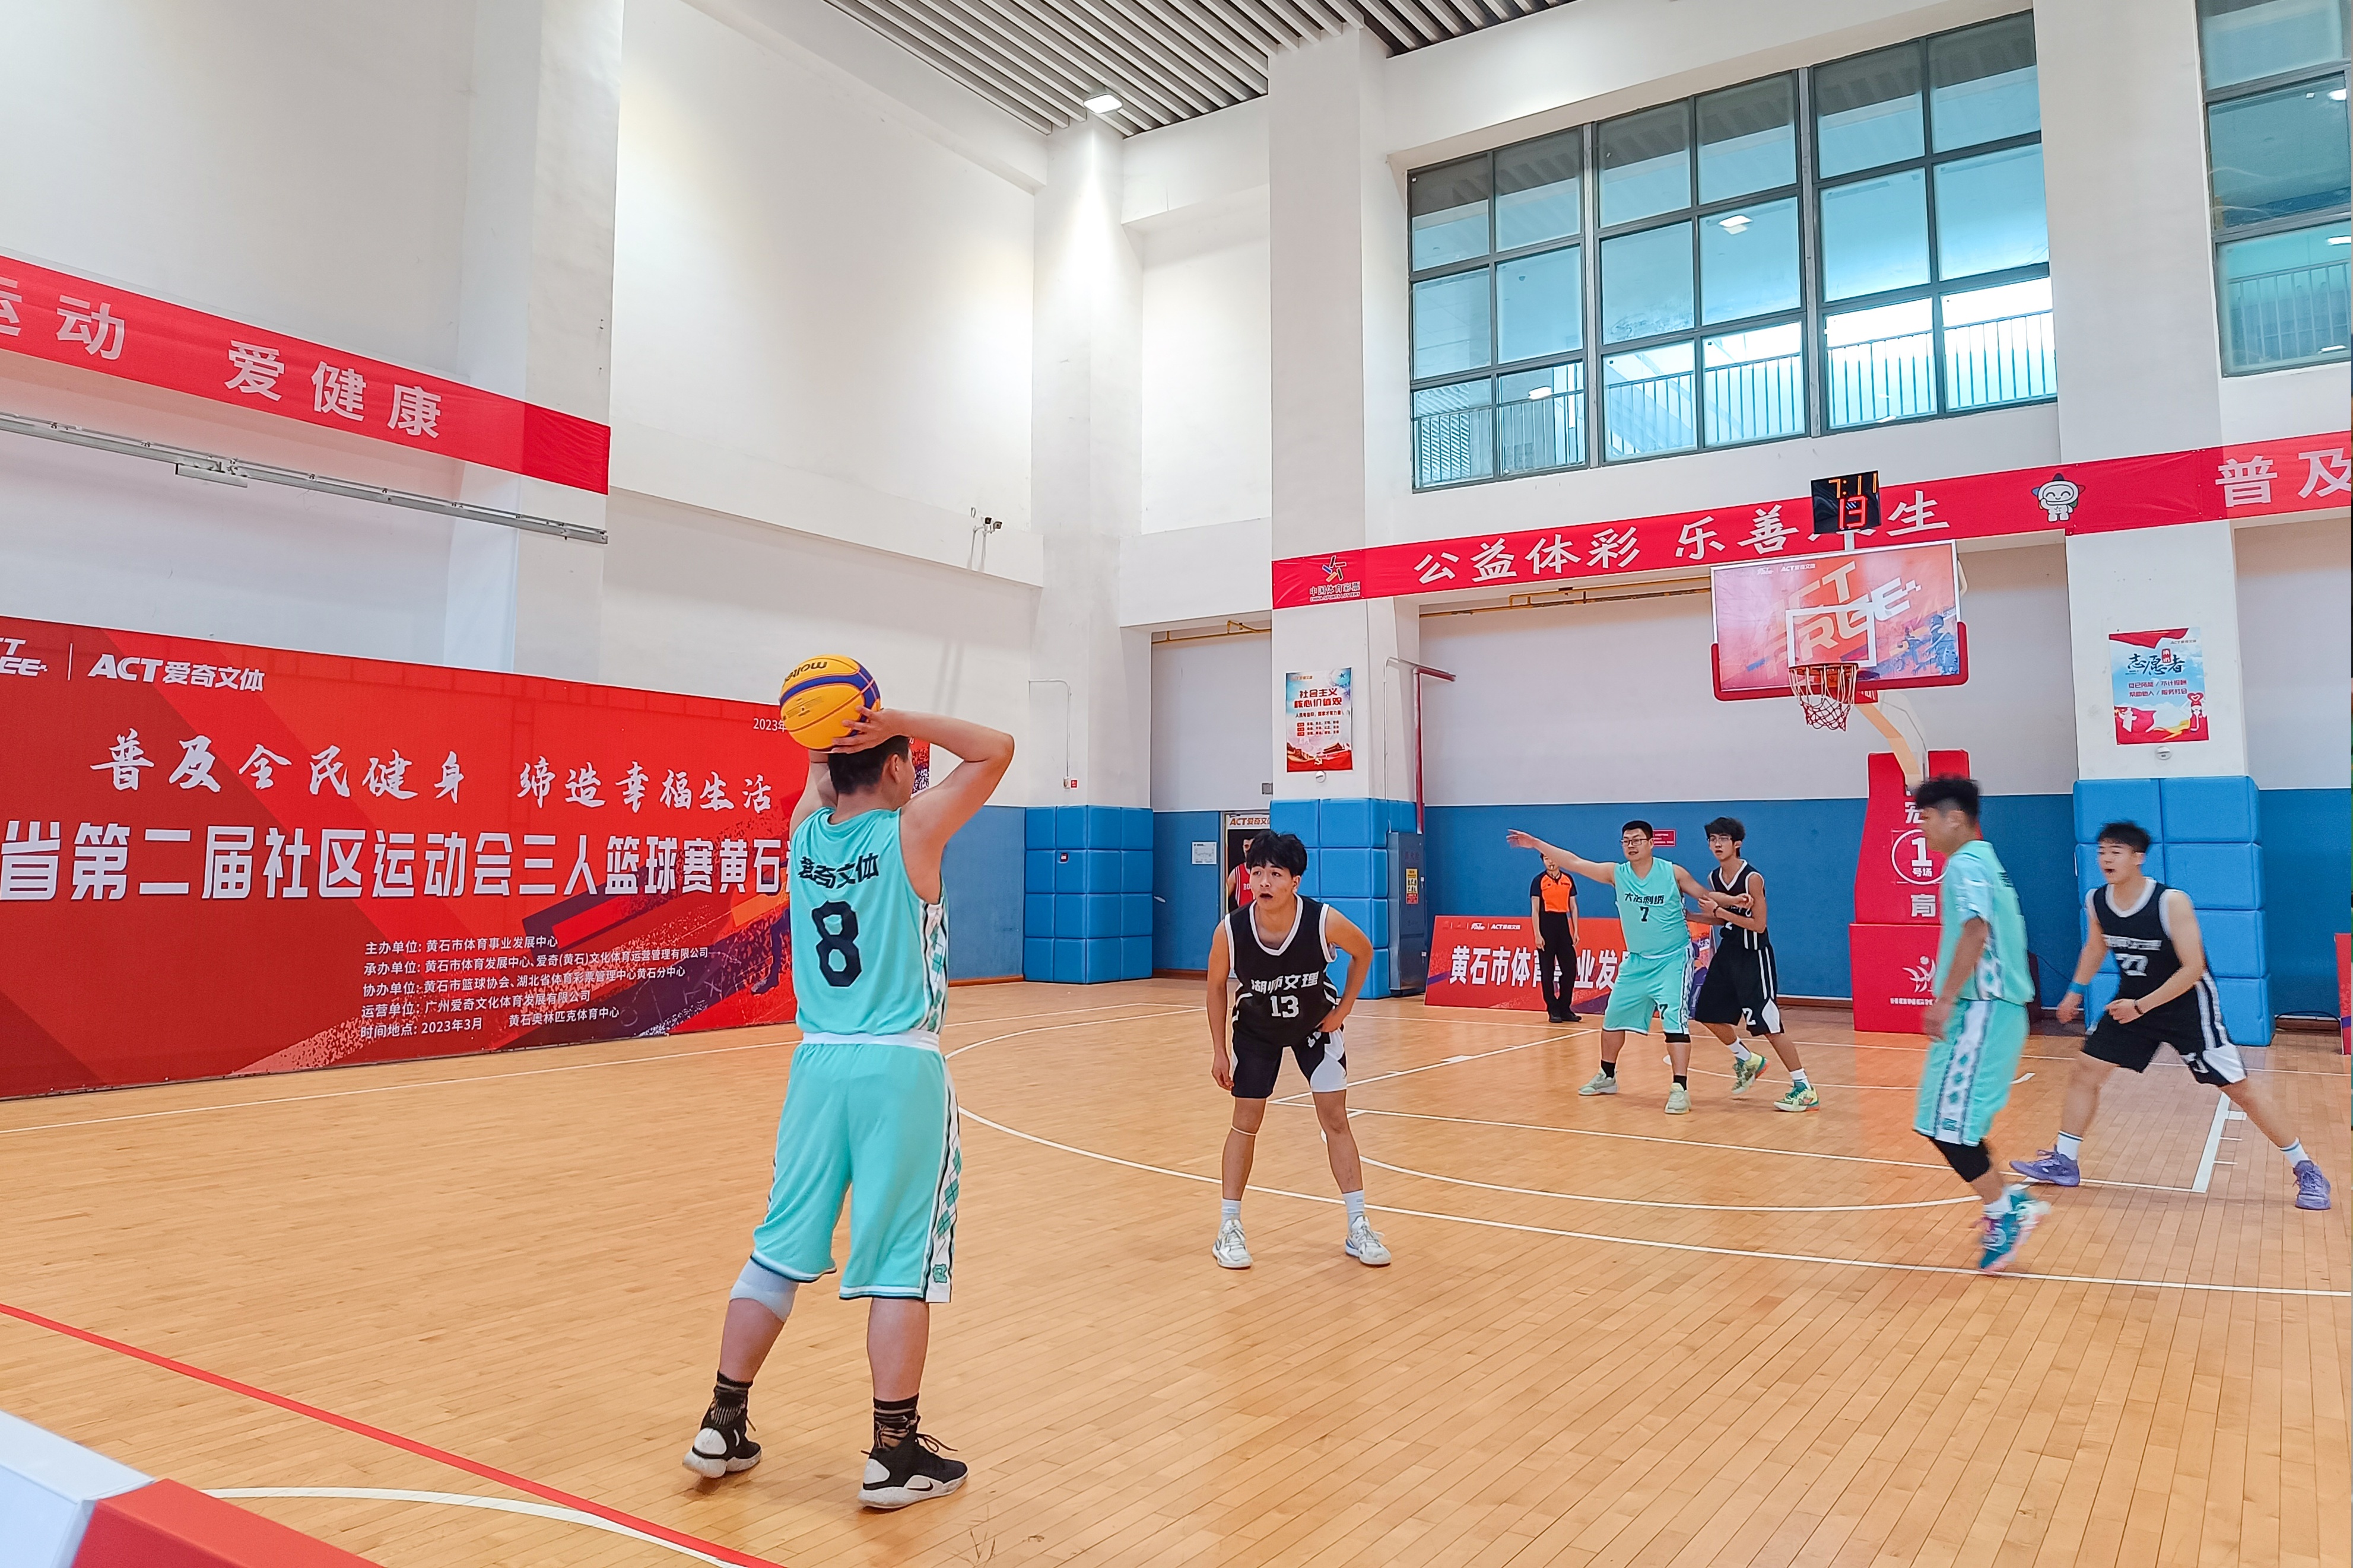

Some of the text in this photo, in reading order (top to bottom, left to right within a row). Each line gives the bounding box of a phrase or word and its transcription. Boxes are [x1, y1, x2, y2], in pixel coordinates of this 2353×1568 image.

[224, 339, 441, 438] 爱健康
[1828, 473, 1877, 498] 7:11
[2215, 447, 2352, 508] 普及
[1839, 495, 1868, 530] 13
[1414, 490, 1950, 584] 公益体彩 乐善生
[1310, 581, 1361, 596] 中国体育彩票
[0, 637, 27, 656] T
[88, 654, 265, 692] ACT爱奇文体
[2127, 653, 2185, 676] 志愿者
[1294, 697, 1342, 708] 核心价值观
[1300, 688, 1337, 698] 社会主义
[90, 727, 773, 814] 普及全民健身 缔造幸福生活
[0, 820, 791, 901] 省第二届社区运动会三人篮球赛黄石
[1911, 837, 1933, 867] 1
[1912, 867, 1933, 877] 号场
[1640, 906, 1649, 922] 7
[1910, 893, 1936, 918] 育
[811, 900, 862, 987] 8
[1449, 945, 1631, 991] 黄石市体业发
[1250, 971, 1319, 994] 湖师文理
[1270, 995, 1300, 1018] 13
[1890, 997, 1933, 1006] HONGK
[1742, 1007, 1757, 1026] 2
